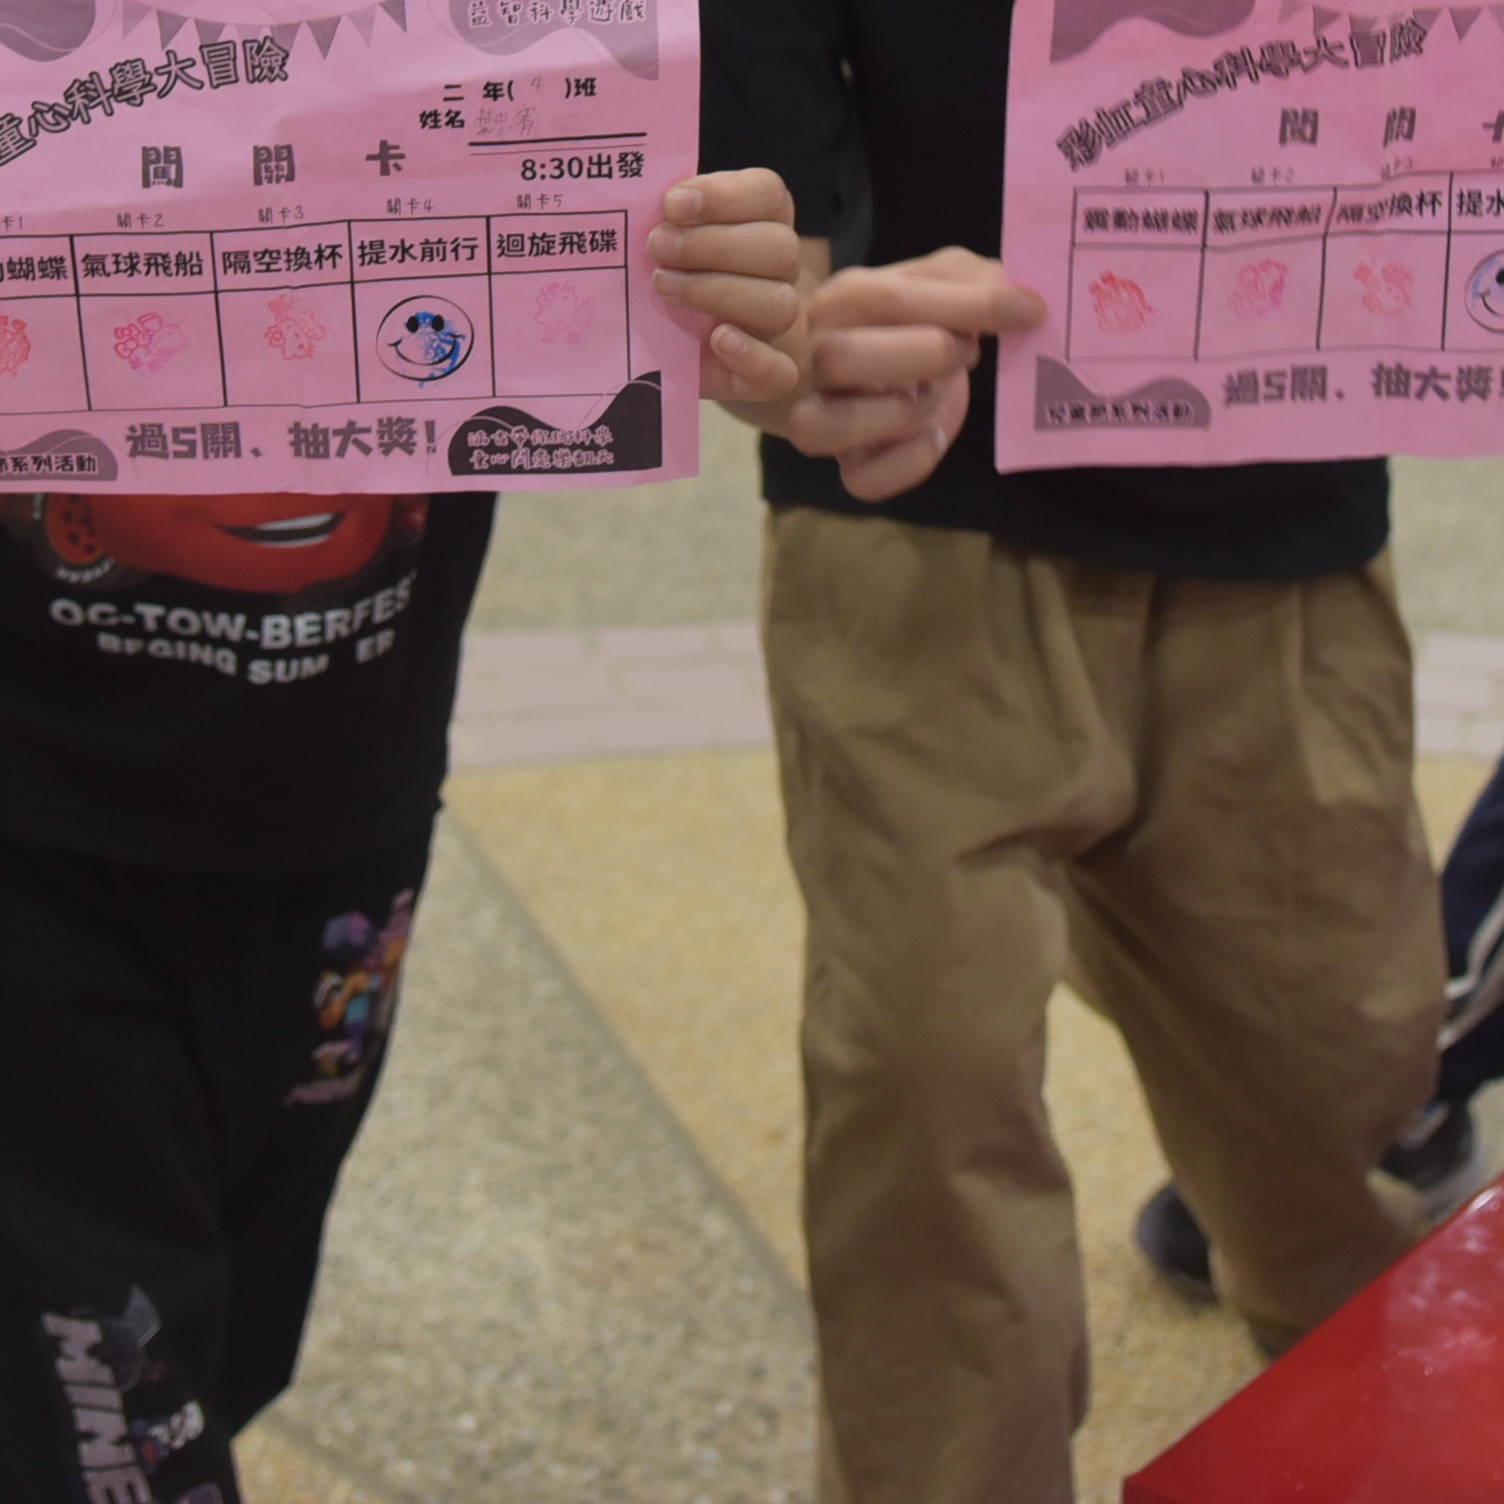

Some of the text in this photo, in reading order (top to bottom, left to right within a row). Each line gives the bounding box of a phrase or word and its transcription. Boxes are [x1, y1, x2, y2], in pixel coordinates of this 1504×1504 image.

[419, 109, 466, 130] 姓名
[520, 152, 646, 181] 8:30出發
[258, 205, 304, 223] 關卡3
[386, 198, 434, 215] 關卡4
[516, 193, 564, 210] 關卡5
[116, 212, 165, 229] 關卡2
[358, 236, 480, 267] 提水前行
[496, 229, 618, 259] 迴旋飛碟
[81, 250, 204, 279] 氣球飛船
[222, 243, 344, 276] 隔空換杯
